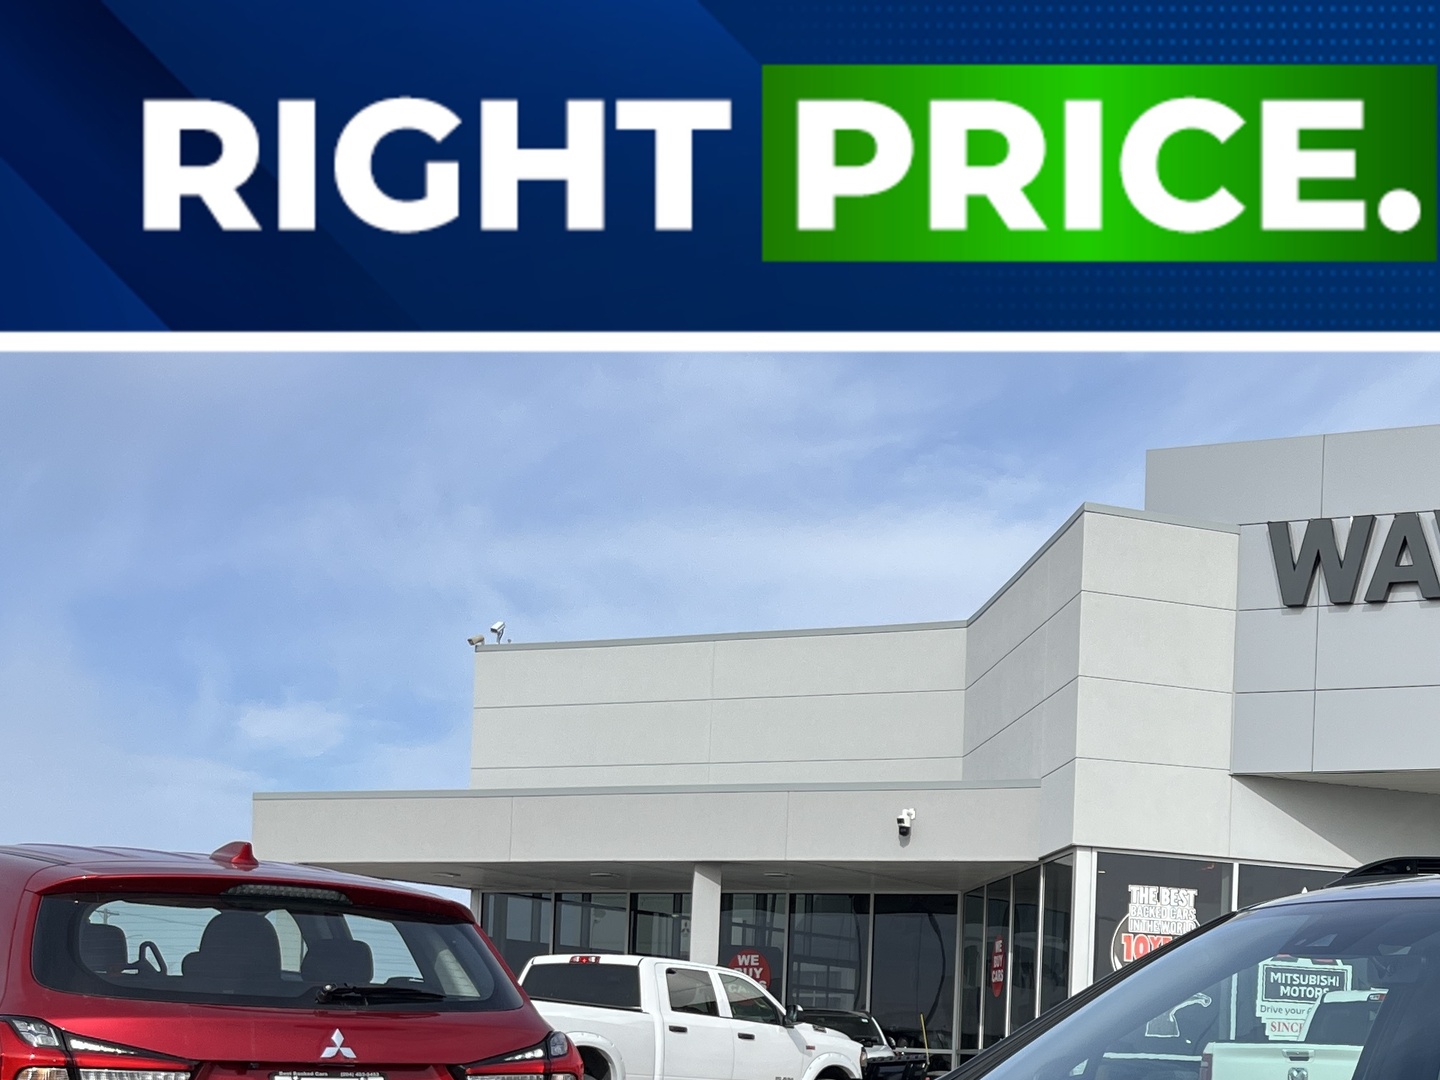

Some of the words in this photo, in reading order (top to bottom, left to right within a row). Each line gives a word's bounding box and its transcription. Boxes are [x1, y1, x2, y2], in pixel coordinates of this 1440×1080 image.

[1129, 885, 1158, 905] THE
[1160, 887, 1198, 908] BEST
[1130, 905, 1167, 920] BACKED
[1170, 907, 1196, 920] CARS
[1142, 920, 1159, 933] THE
[995, 940, 1003, 953] WE
[737, 954, 760, 966] WE
[992, 969, 1004, 983] CARS
[1270, 972, 1340, 987] MITSUBISHI
[1260, 1004, 1283, 1015] Drive
[1285, 1007, 1306, 1016] your
